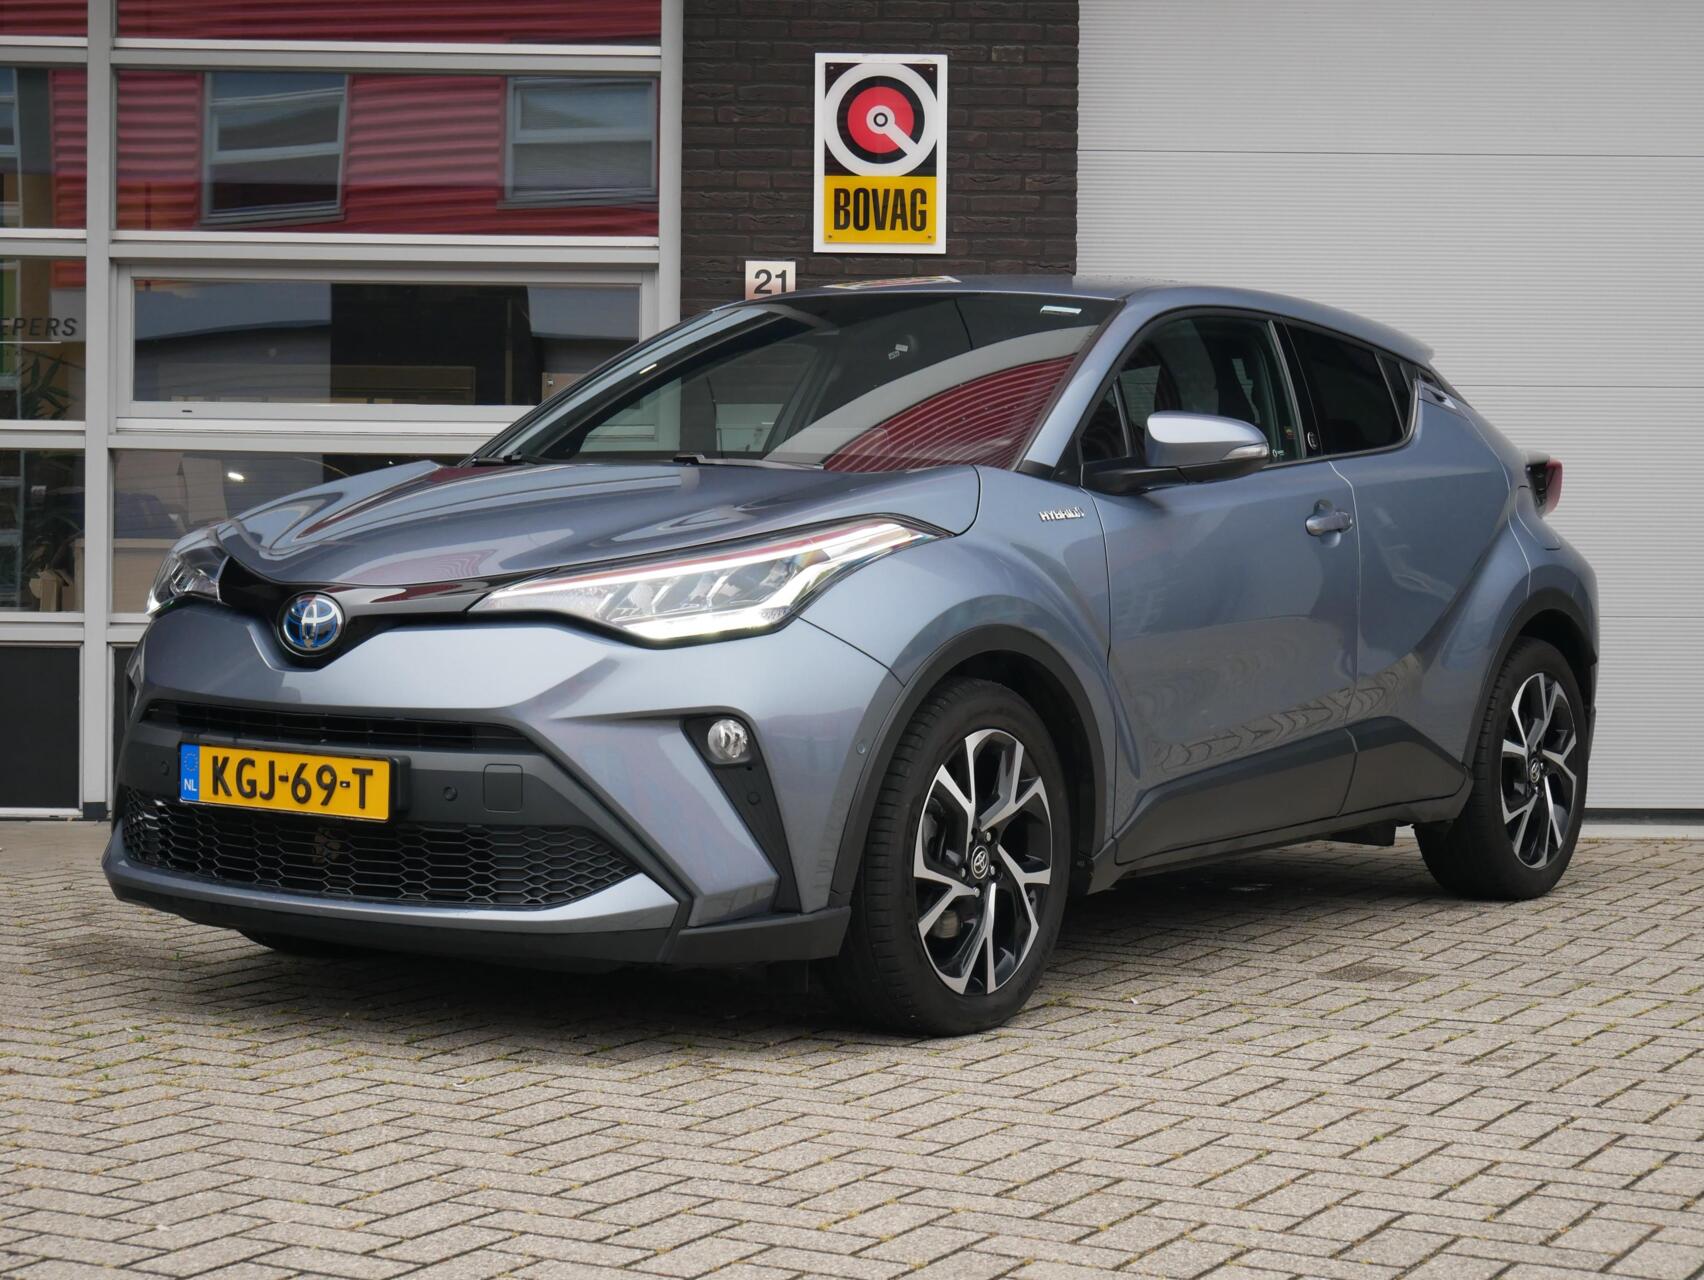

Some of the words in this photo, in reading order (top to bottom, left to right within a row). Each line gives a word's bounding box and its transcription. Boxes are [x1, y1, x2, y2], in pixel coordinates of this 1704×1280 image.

[833, 187, 927, 232] BOVAG
[753, 268, 787, 295] 21
[184, 778, 197, 791] NL
[211, 755, 374, 810] KGJ-69-T
